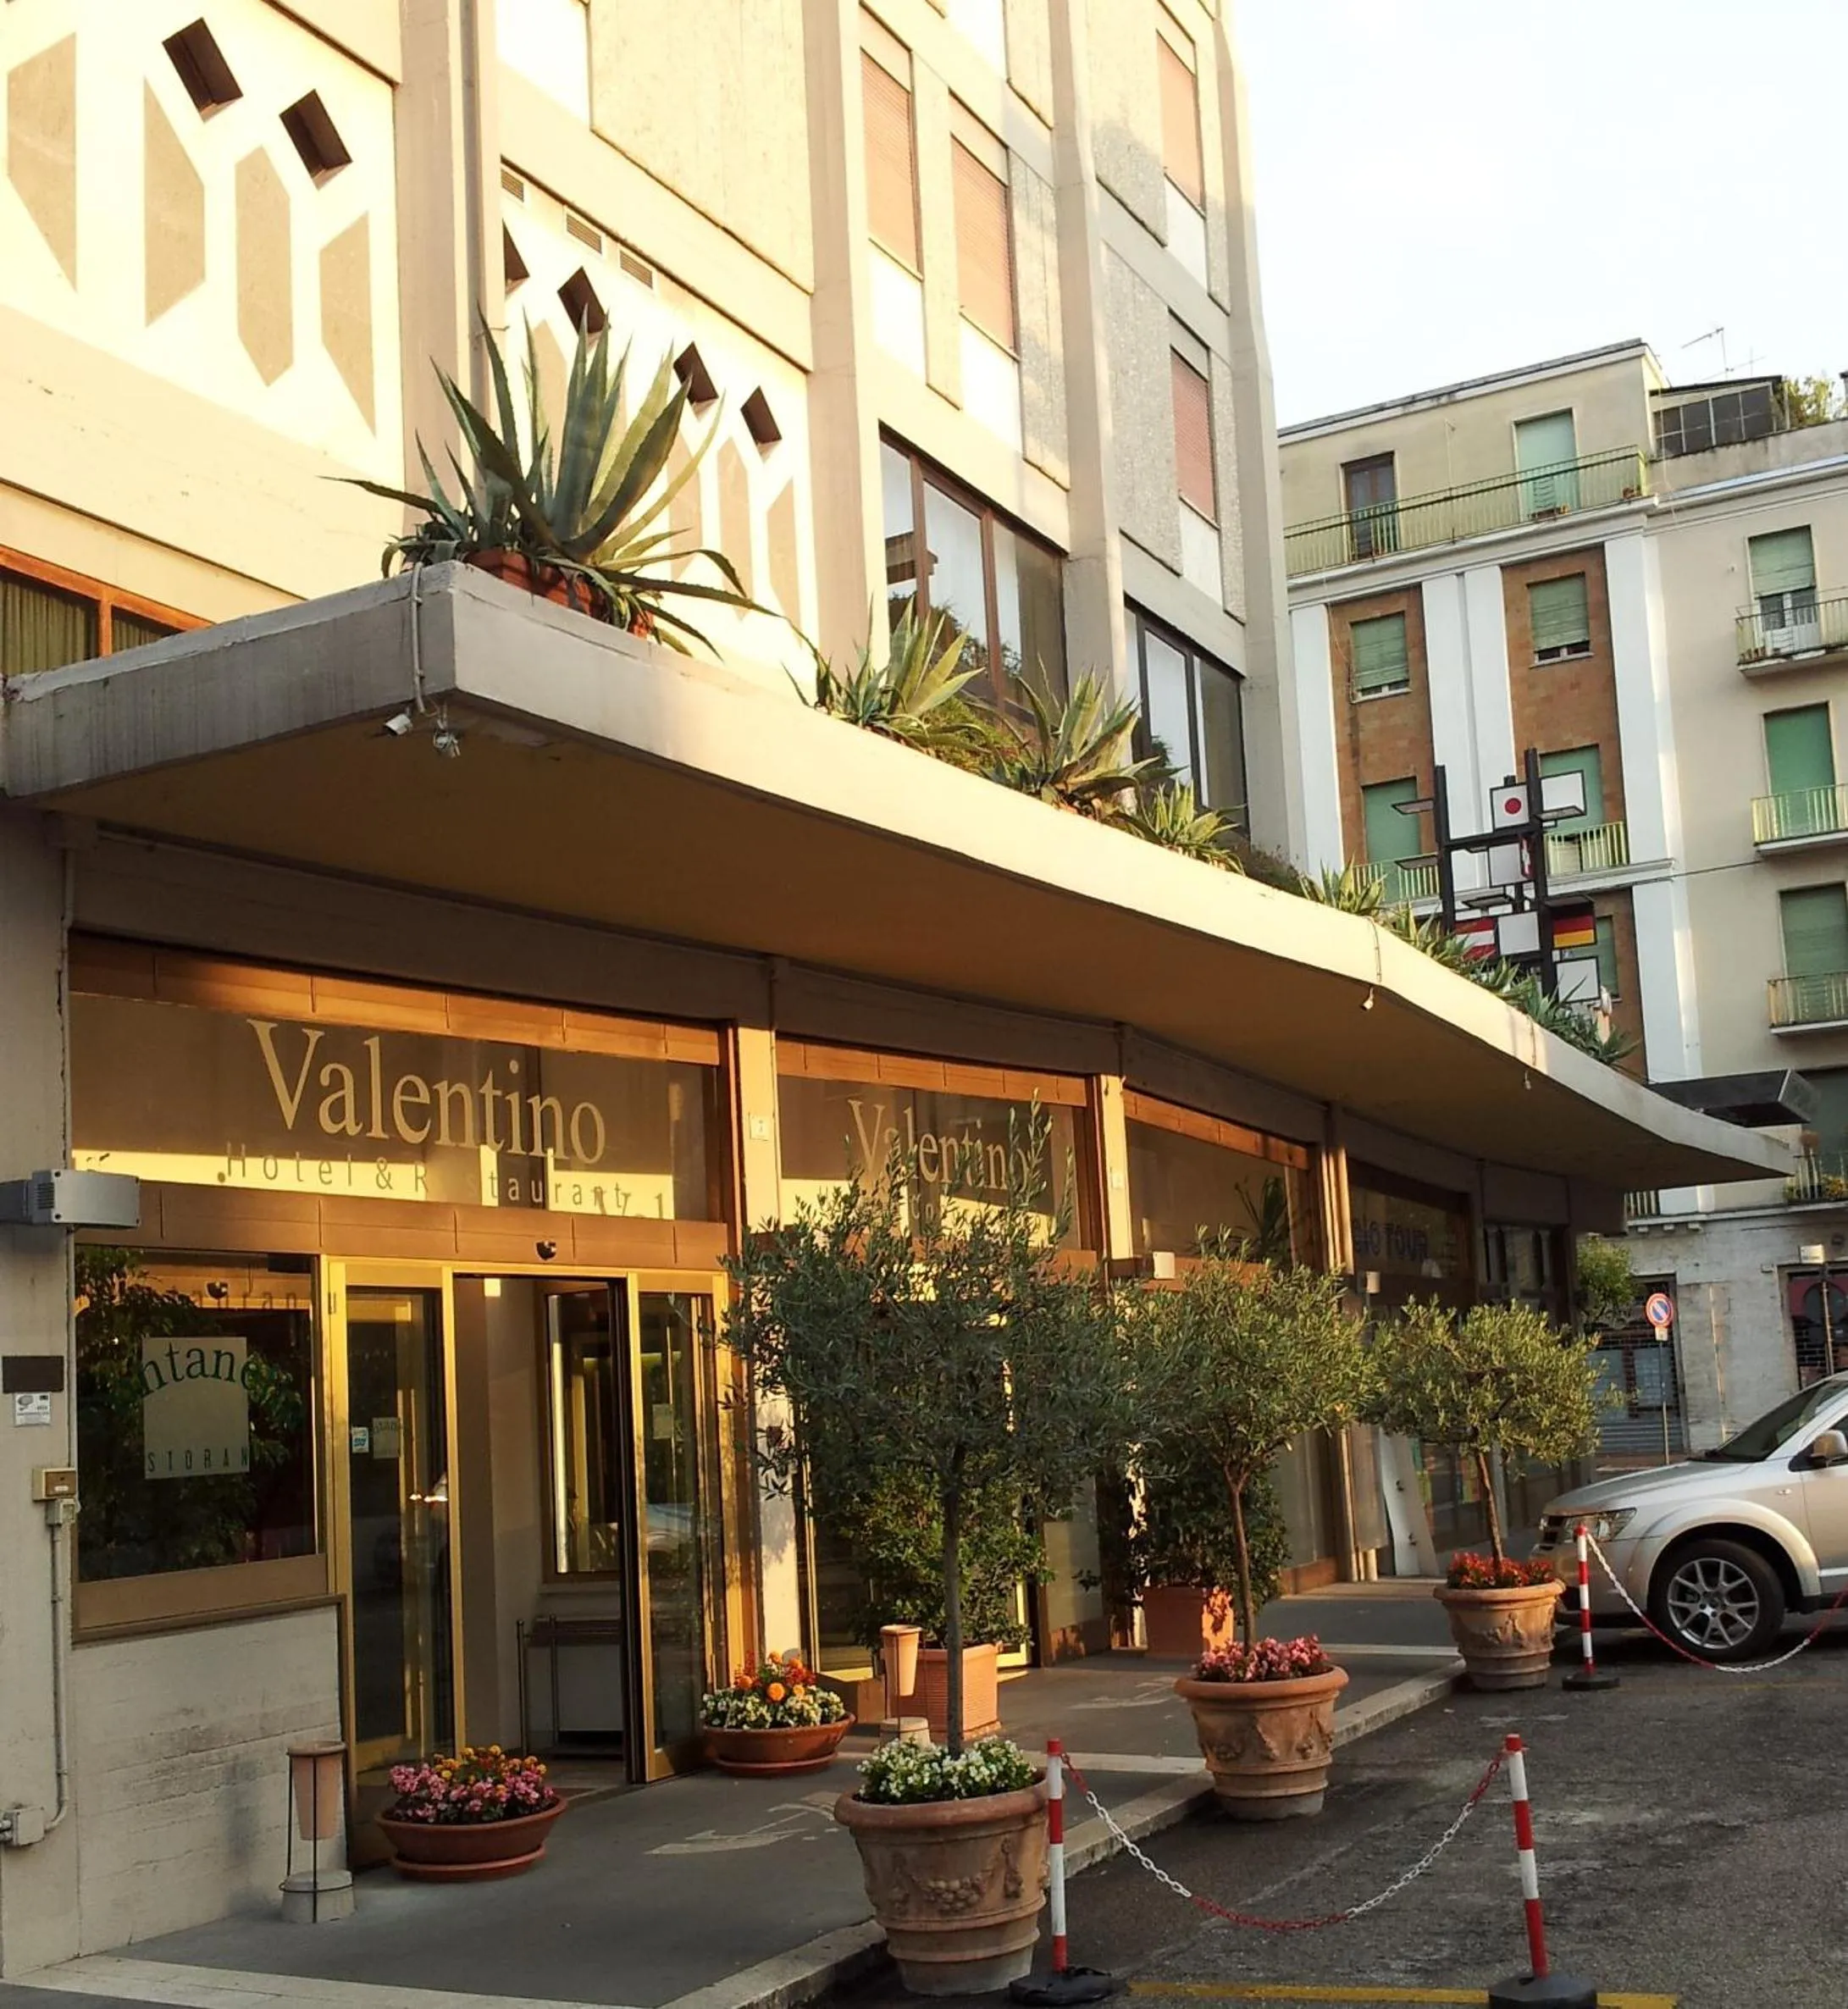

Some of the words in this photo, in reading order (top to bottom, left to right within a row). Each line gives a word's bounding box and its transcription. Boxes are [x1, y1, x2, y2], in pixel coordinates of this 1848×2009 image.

[246, 1019, 606, 1165] Valentino
[226, 1143, 352, 1186] Hotel
[376, 1157, 394, 1191] &
[414, 1160, 622, 1208] Rtaurant
